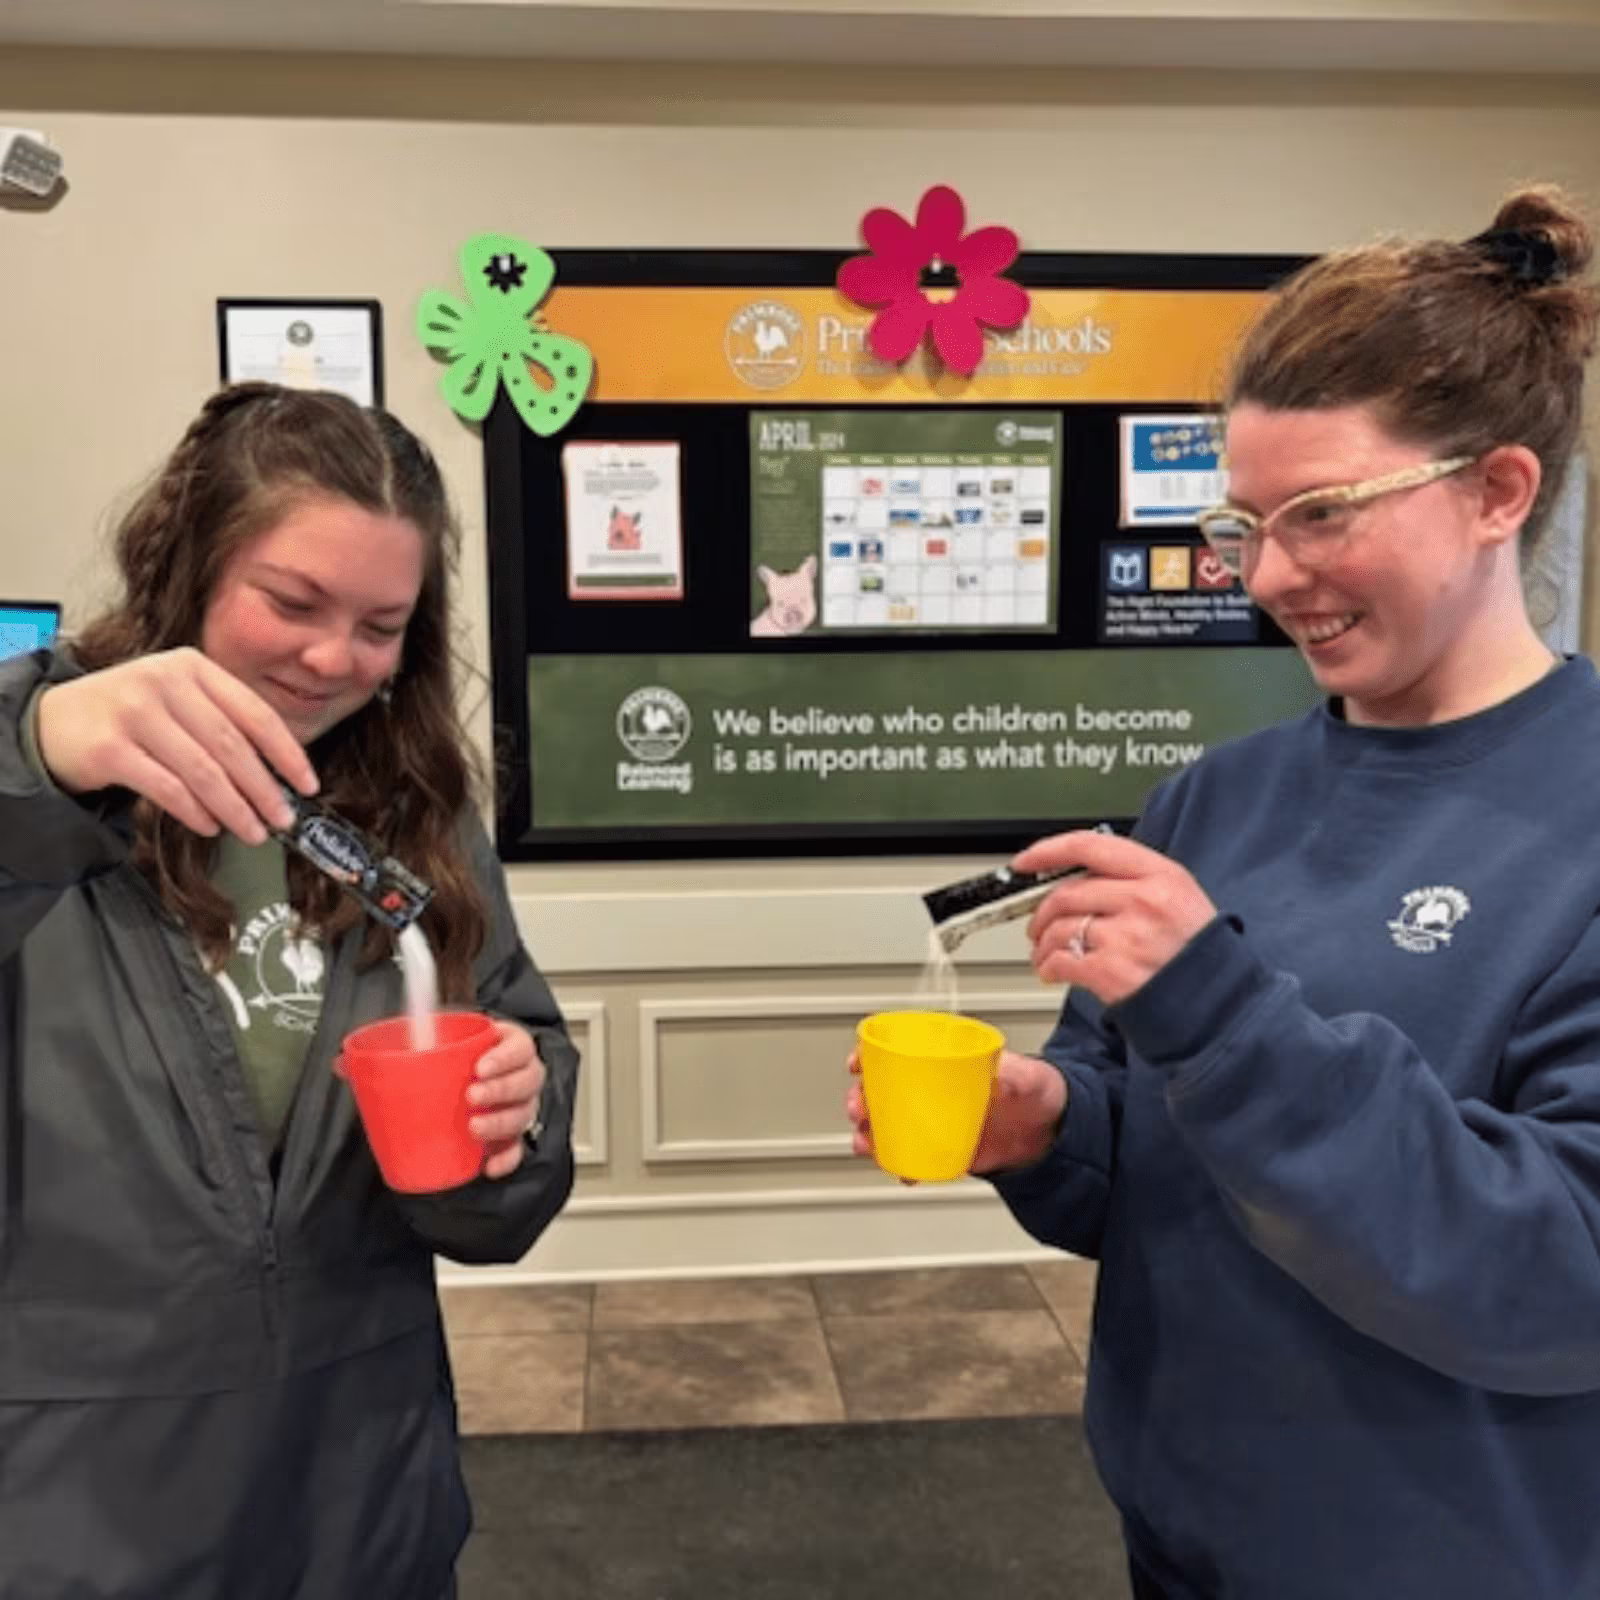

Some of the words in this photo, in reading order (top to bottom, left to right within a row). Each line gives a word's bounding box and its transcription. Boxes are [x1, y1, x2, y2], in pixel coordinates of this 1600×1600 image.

[984, 317, 1111, 354] Schools
[759, 420, 814, 450] APRIL
[713, 710, 759, 735] We
[770, 709, 873, 735] believe
[882, 708, 943, 733] who
[952, 706, 1066, 732] children
[1076, 705, 1191, 731] become
[714, 749, 736, 772] is
[746, 750, 776, 772] as
[785, 744, 926, 778] important
[936, 747, 966, 769] as
[975, 741, 1044, 768] what
[1053, 739, 1117, 774] they
[1126, 738, 1203, 766] know
